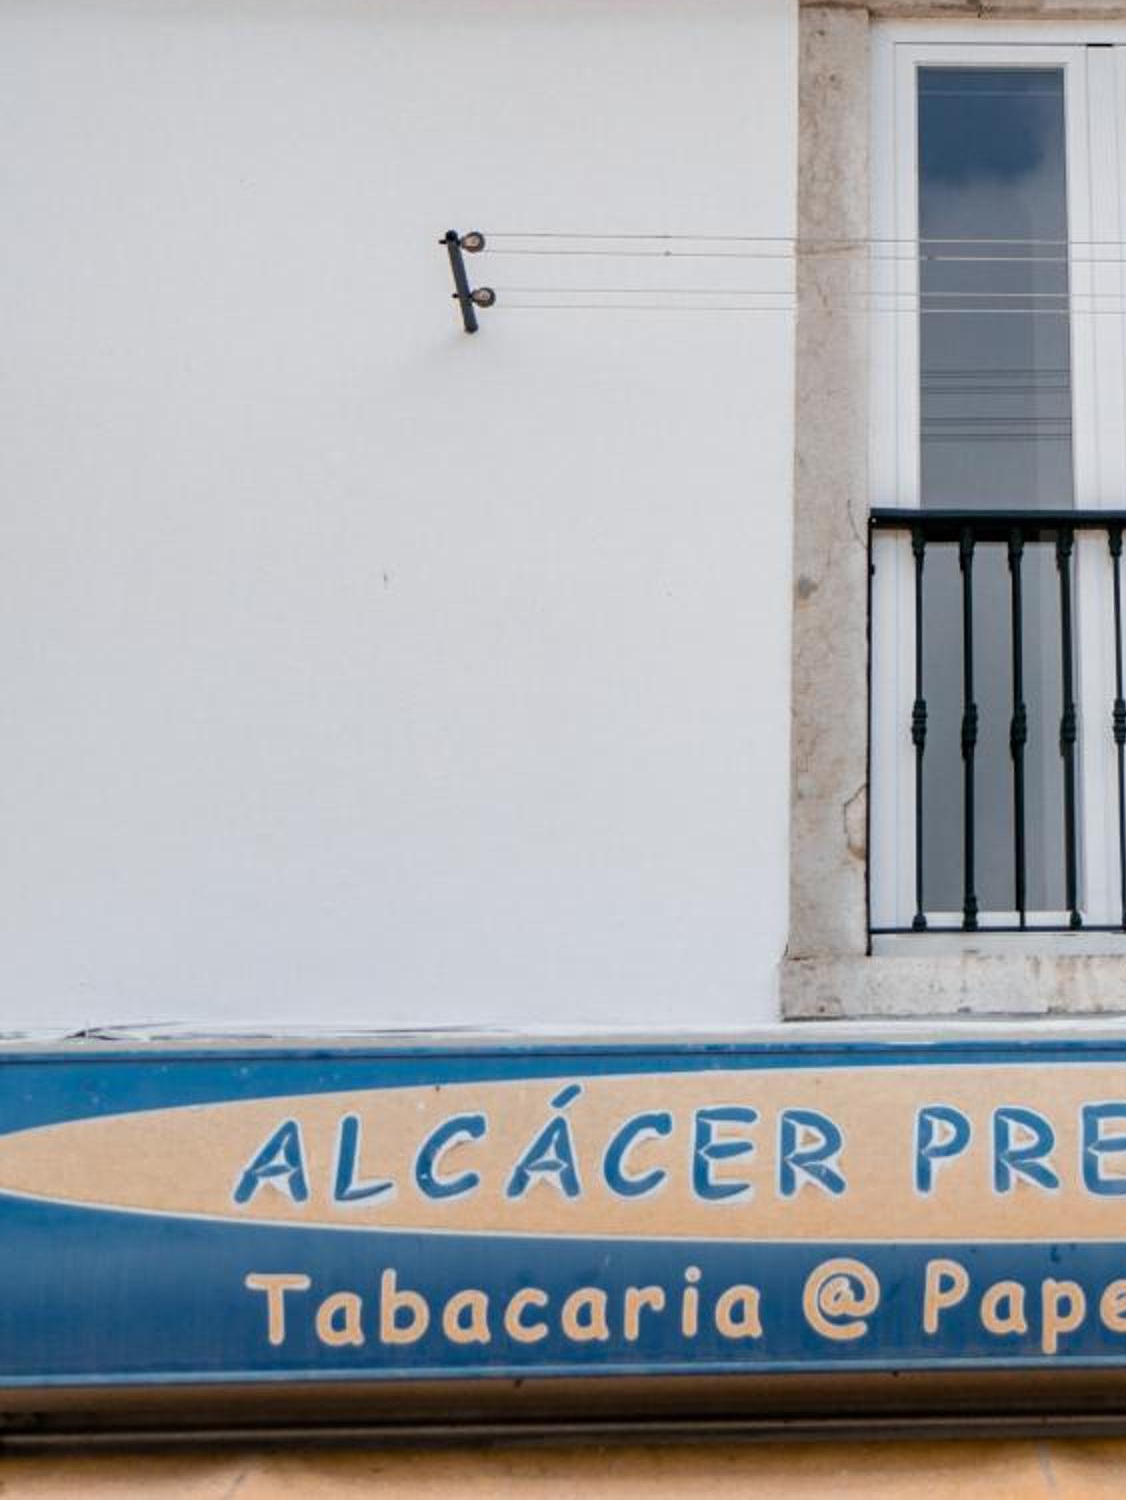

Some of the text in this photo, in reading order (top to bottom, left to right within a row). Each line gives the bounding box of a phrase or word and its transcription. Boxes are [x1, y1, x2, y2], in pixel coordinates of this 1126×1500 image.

[232, 1084, 848, 1206] ALCÁCER
[245, 1266, 764, 1347] Tabacaria
[802, 1258, 880, 1341] @
